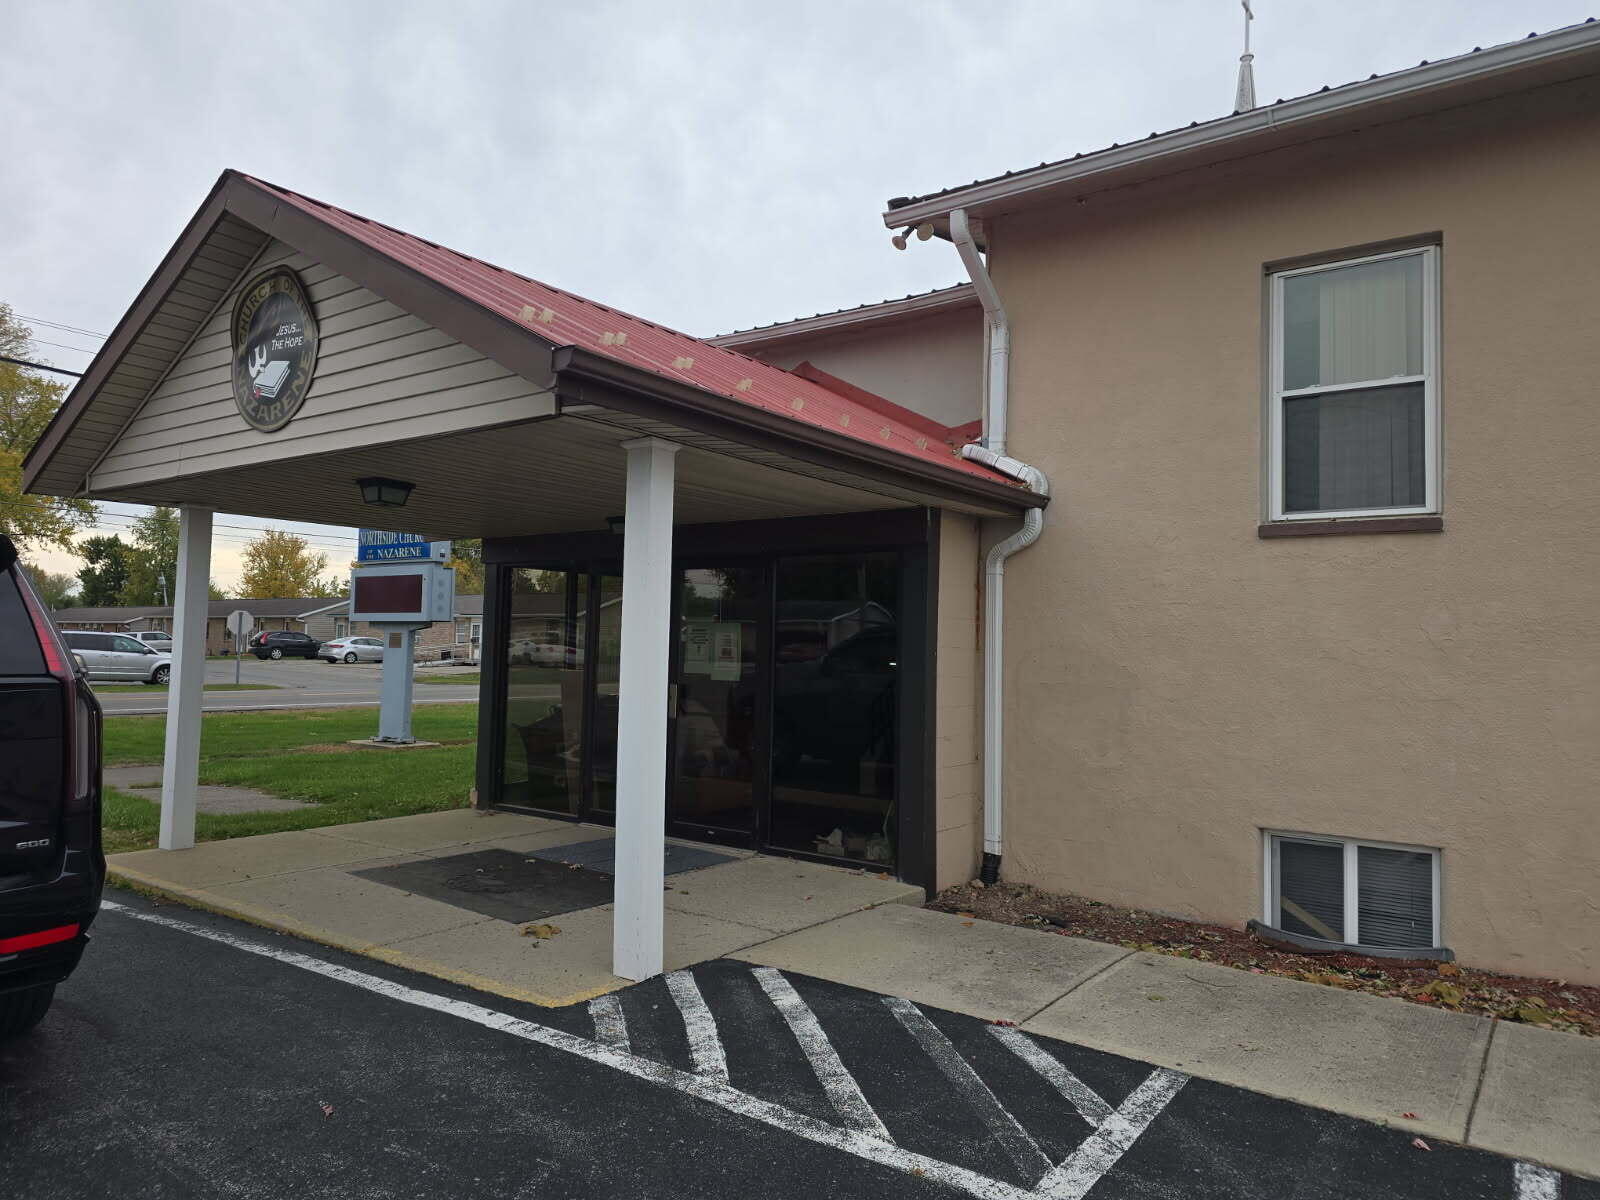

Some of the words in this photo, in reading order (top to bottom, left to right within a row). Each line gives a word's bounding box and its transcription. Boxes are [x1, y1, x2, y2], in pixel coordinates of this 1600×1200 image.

[239, 280, 276, 345] CHURCH
[271, 339, 284, 351] THE
[284, 336, 303, 349] HOPE
[360, 531, 397, 546] NORTHSIDE
[377, 547, 422, 559] NAZARENE
